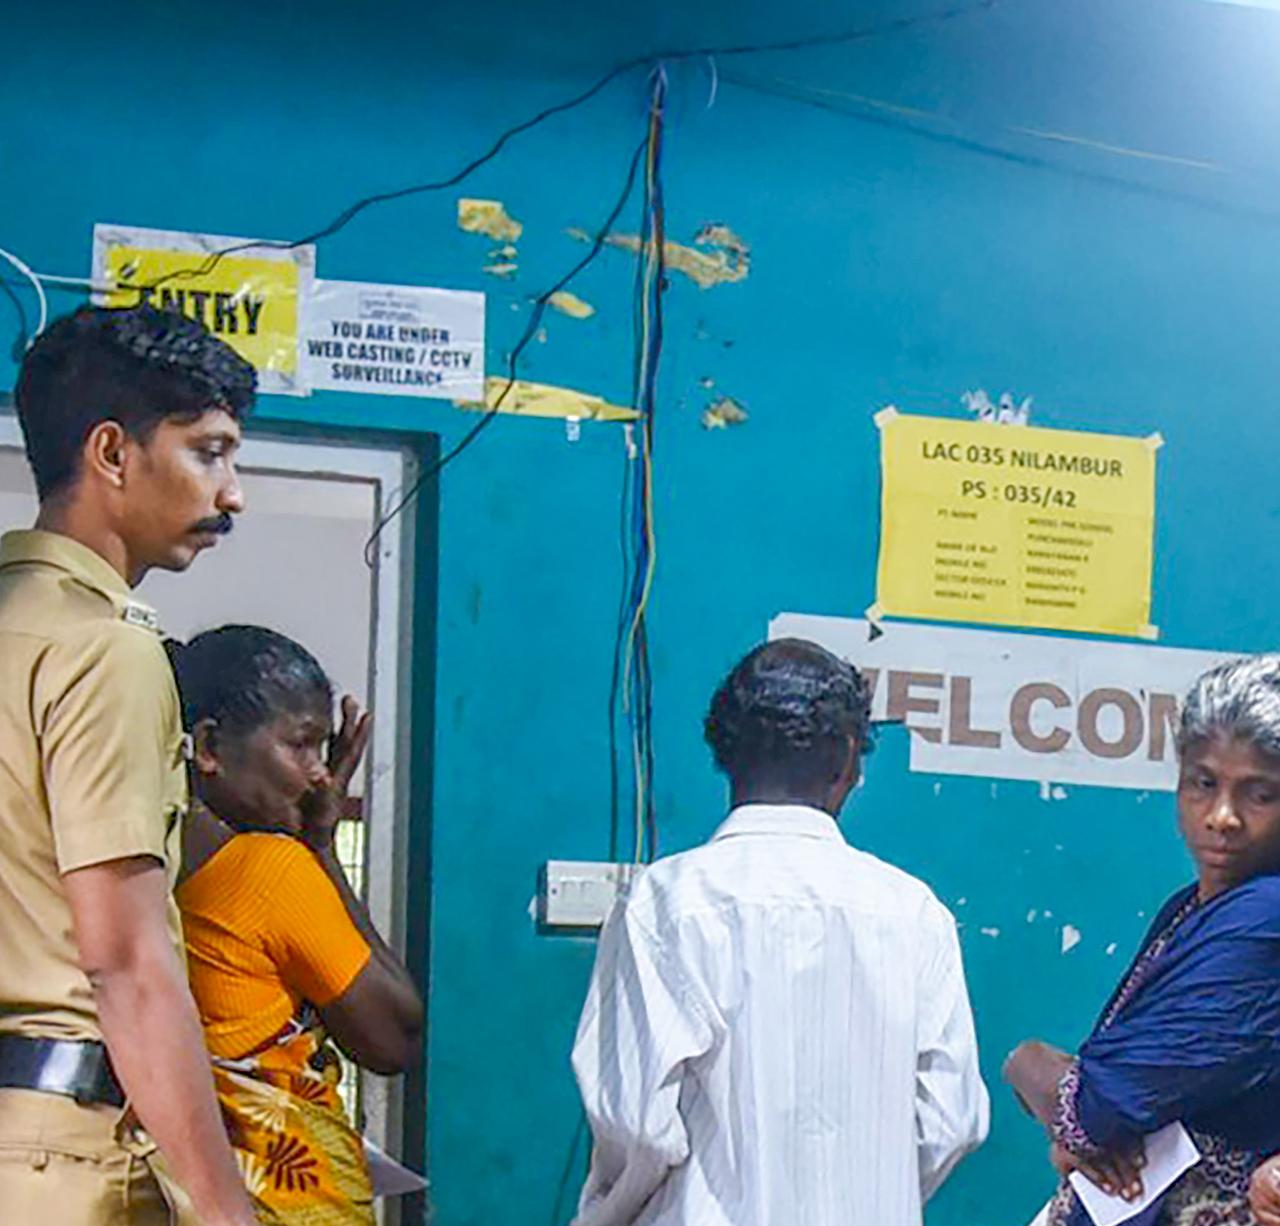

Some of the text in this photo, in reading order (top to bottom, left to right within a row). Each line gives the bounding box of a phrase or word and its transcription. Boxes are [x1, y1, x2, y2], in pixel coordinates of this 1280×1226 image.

[331, 321, 450, 344] YOU ARE UNDER
[308, 340, 472, 368] WEB CASTING / CCTV
[922, 441, 1123, 478] LAC 035 NILAMBUR
[962, 480, 987, 500] PS
[1005, 484, 1076, 508] 035/42
[861, 667, 1177, 762] ELCO
